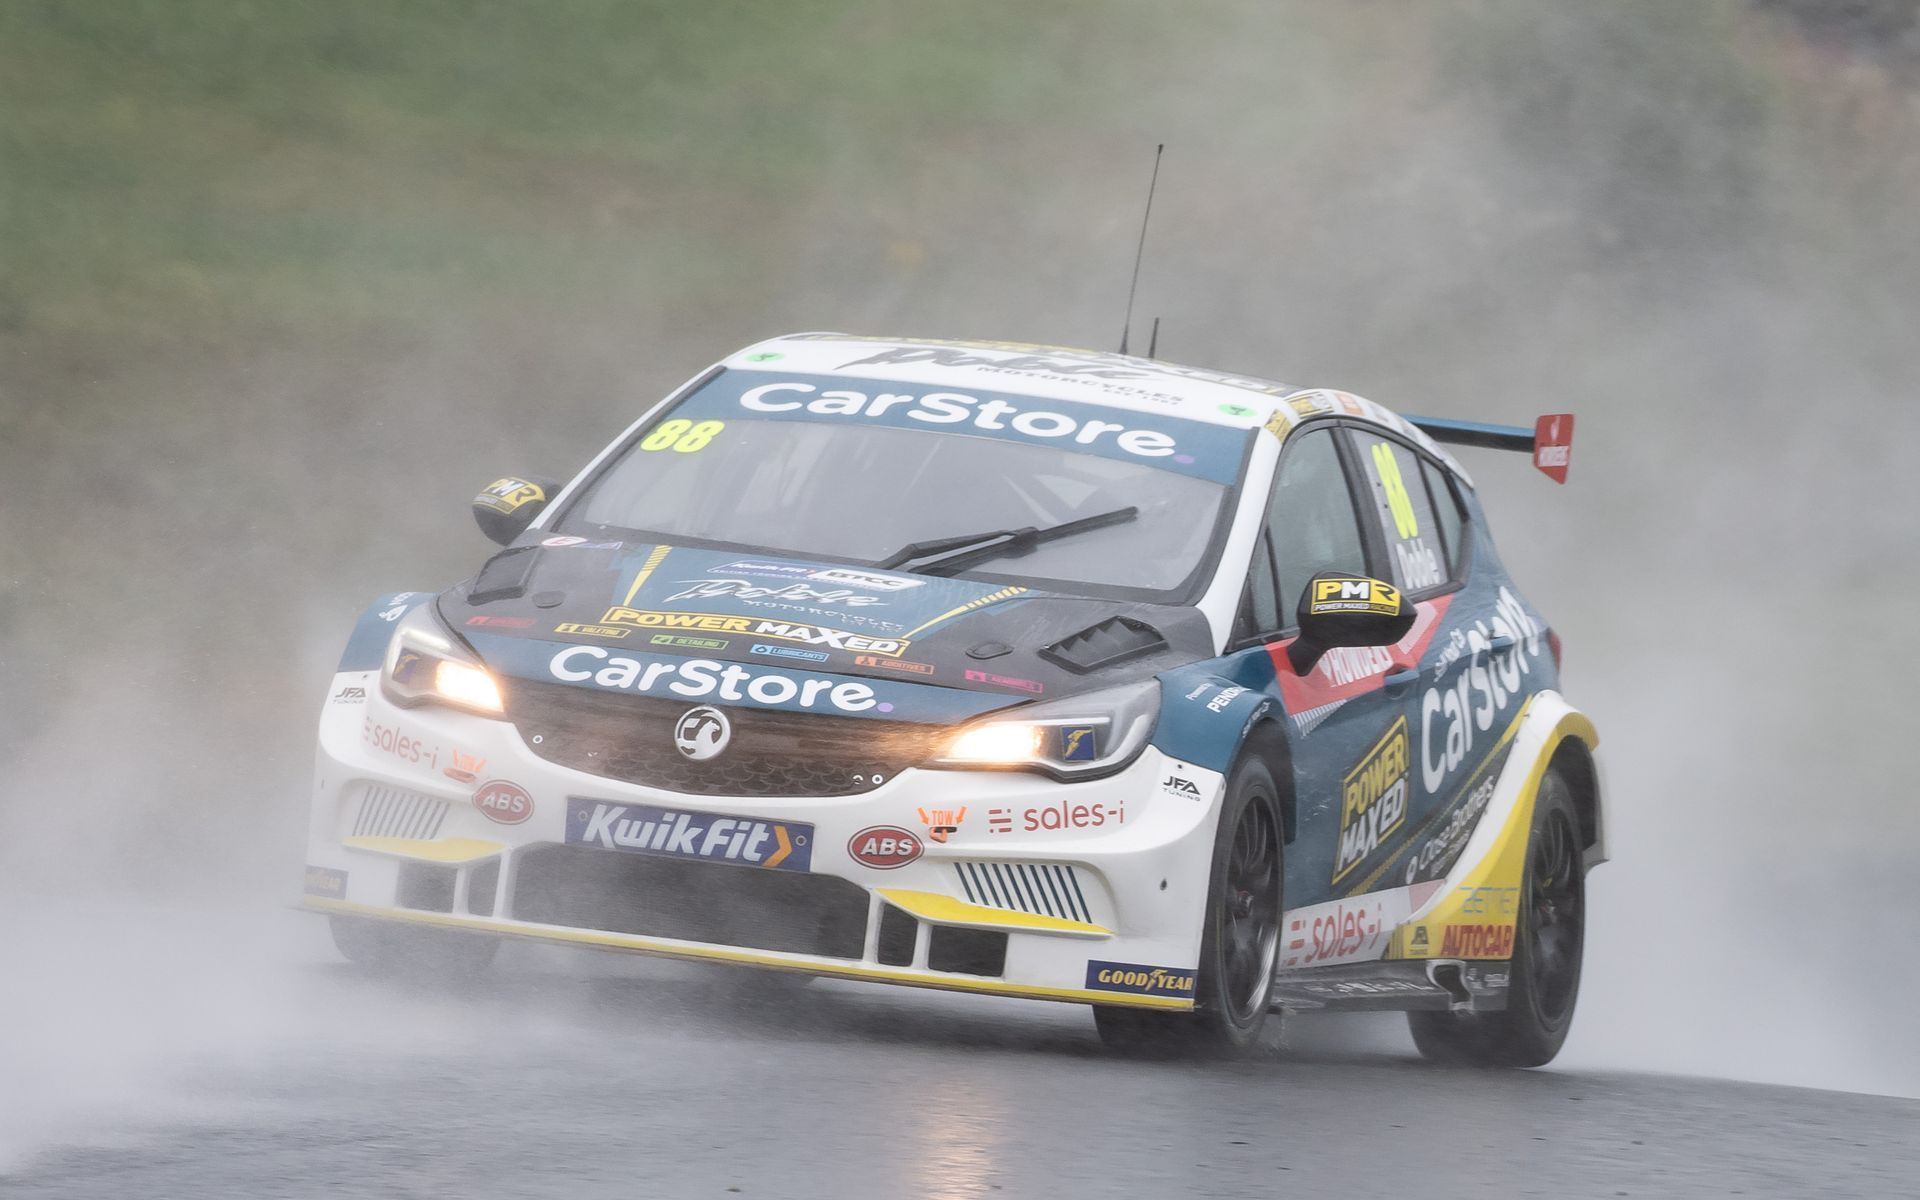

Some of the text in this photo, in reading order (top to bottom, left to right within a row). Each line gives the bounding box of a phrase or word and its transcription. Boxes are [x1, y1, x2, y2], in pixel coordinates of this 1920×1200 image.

[640, 419, 725, 453] 88
[826, 571, 904, 587] BTCC
[1316, 581, 1396, 602] PMR
[610, 611, 751, 632] POWER
[757, 621, 900, 653] MAXED
[676, 636, 719, 648] DETAILING
[771, 646, 827, 660] LUBRICANTS
[372, 724, 440, 770] sales-i
[1163, 775, 1201, 795] JFA
[1344, 733, 1406, 830] POWER
[482, 791, 526, 813] ABS
[1024, 799, 1124, 832] sales-i
[931, 809, 955, 825] TOW
[1337, 777, 1406, 872] MAXED
[860, 837, 914, 856] ABS
[1305, 902, 1383, 964] sales-i
[1440, 924, 1512, 957] AUTOCAR
